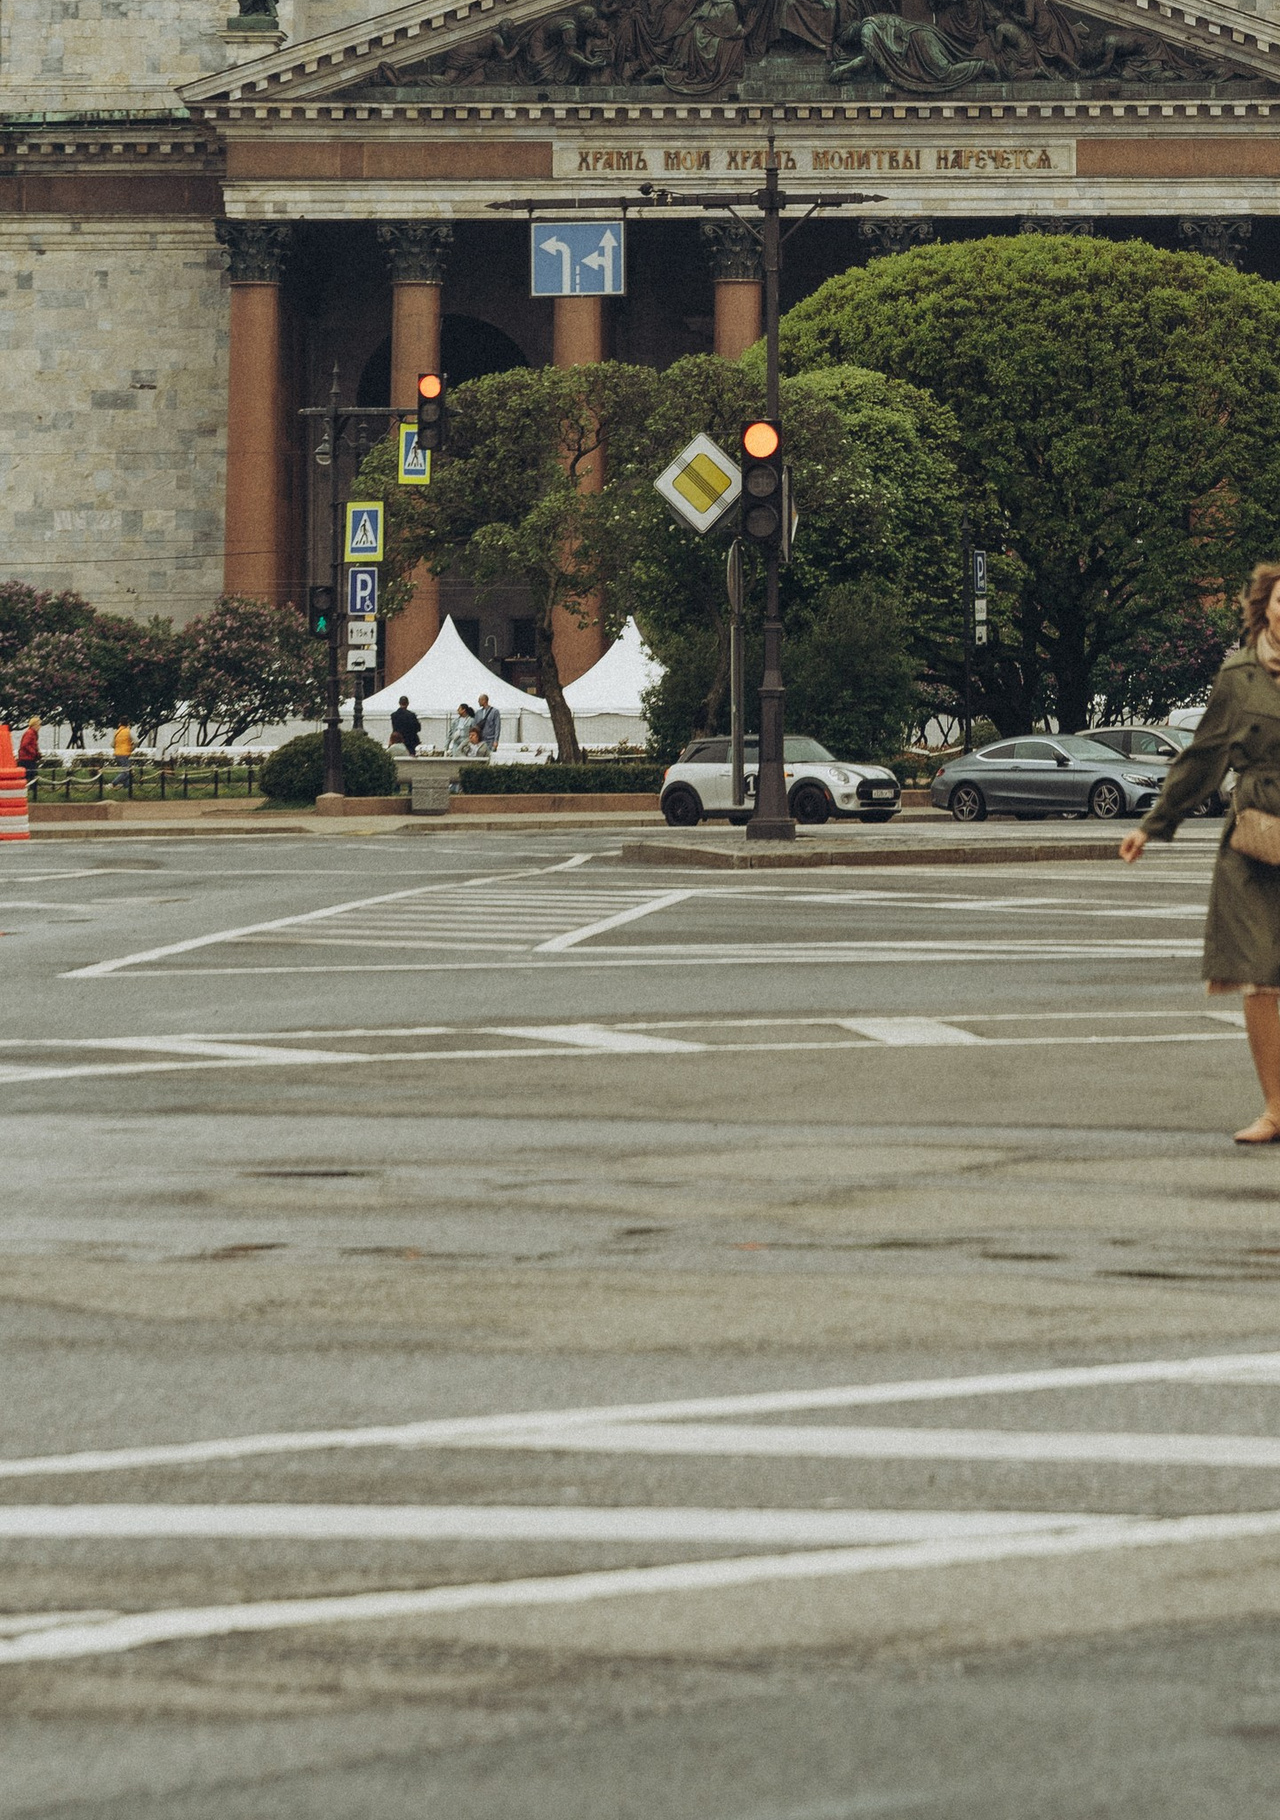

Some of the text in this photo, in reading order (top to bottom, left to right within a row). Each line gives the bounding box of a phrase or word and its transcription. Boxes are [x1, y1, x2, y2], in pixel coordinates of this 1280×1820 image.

[577, 150, 648, 171] ХРАМЪ
[726, 150, 797, 171] ХРАМЪ
[356, 573, 373, 610] P
[746, 775, 757, 795] 1
